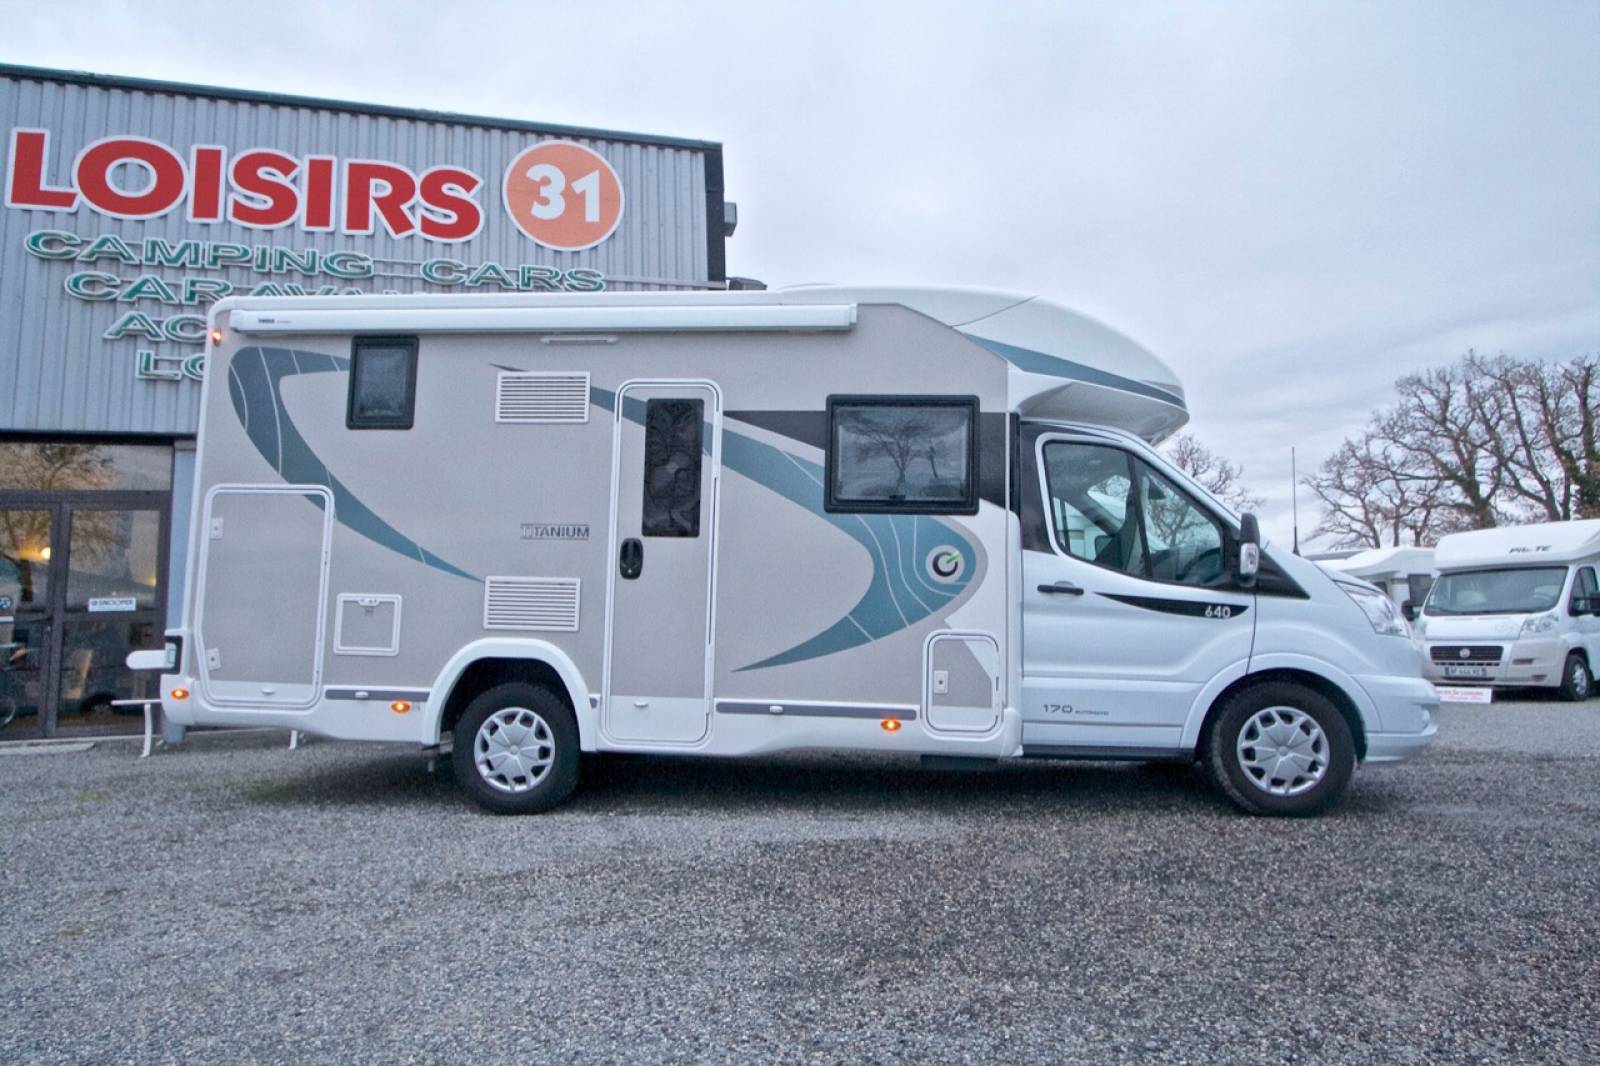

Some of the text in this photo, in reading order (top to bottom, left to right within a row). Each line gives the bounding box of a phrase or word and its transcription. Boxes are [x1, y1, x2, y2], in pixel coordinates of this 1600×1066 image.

[5, 128, 600, 243] LOISIRS 31
[24, 230, 608, 293] CAMPING CARS
[1204, 604, 1231, 619] 640
[1042, 703, 1073, 714] 170
